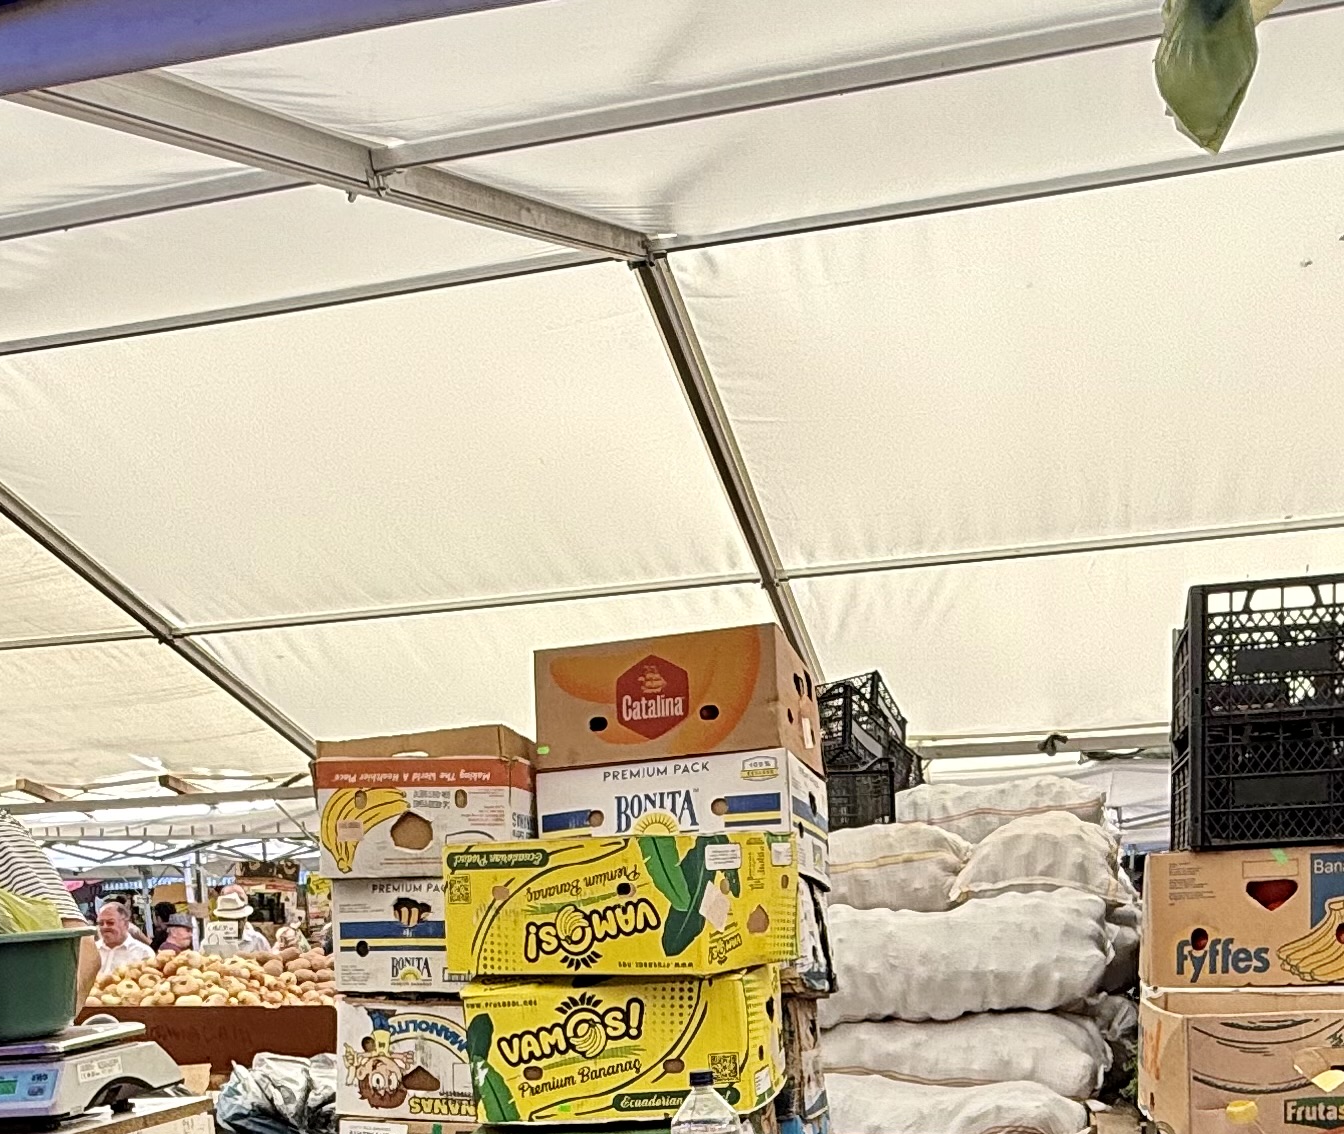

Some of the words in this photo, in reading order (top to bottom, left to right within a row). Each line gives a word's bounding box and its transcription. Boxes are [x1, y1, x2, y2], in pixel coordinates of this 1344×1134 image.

[622, 694, 684, 721] Catalina
[402, 771, 410, 782] A
[439, 771, 457, 782] The
[603, 766, 668, 782] PREMIUM
[673, 760, 710, 775] PACK
[615, 789, 699, 835] BONITA
[452, 853, 488, 868] Product
[489, 851, 543, 864] Ecuadorian
[582, 864, 640, 888] Premium
[372, 883, 423, 894] PREMIUM
[426, 883, 446, 893] PAC
[524, 898, 662, 964] VAMOS!
[390, 956, 432, 978] BONITA
[497, 998, 644, 1066] VAMOS!
[517, 1073, 577, 1099] Premium
[408, 1096, 477, 1117] NANAS
